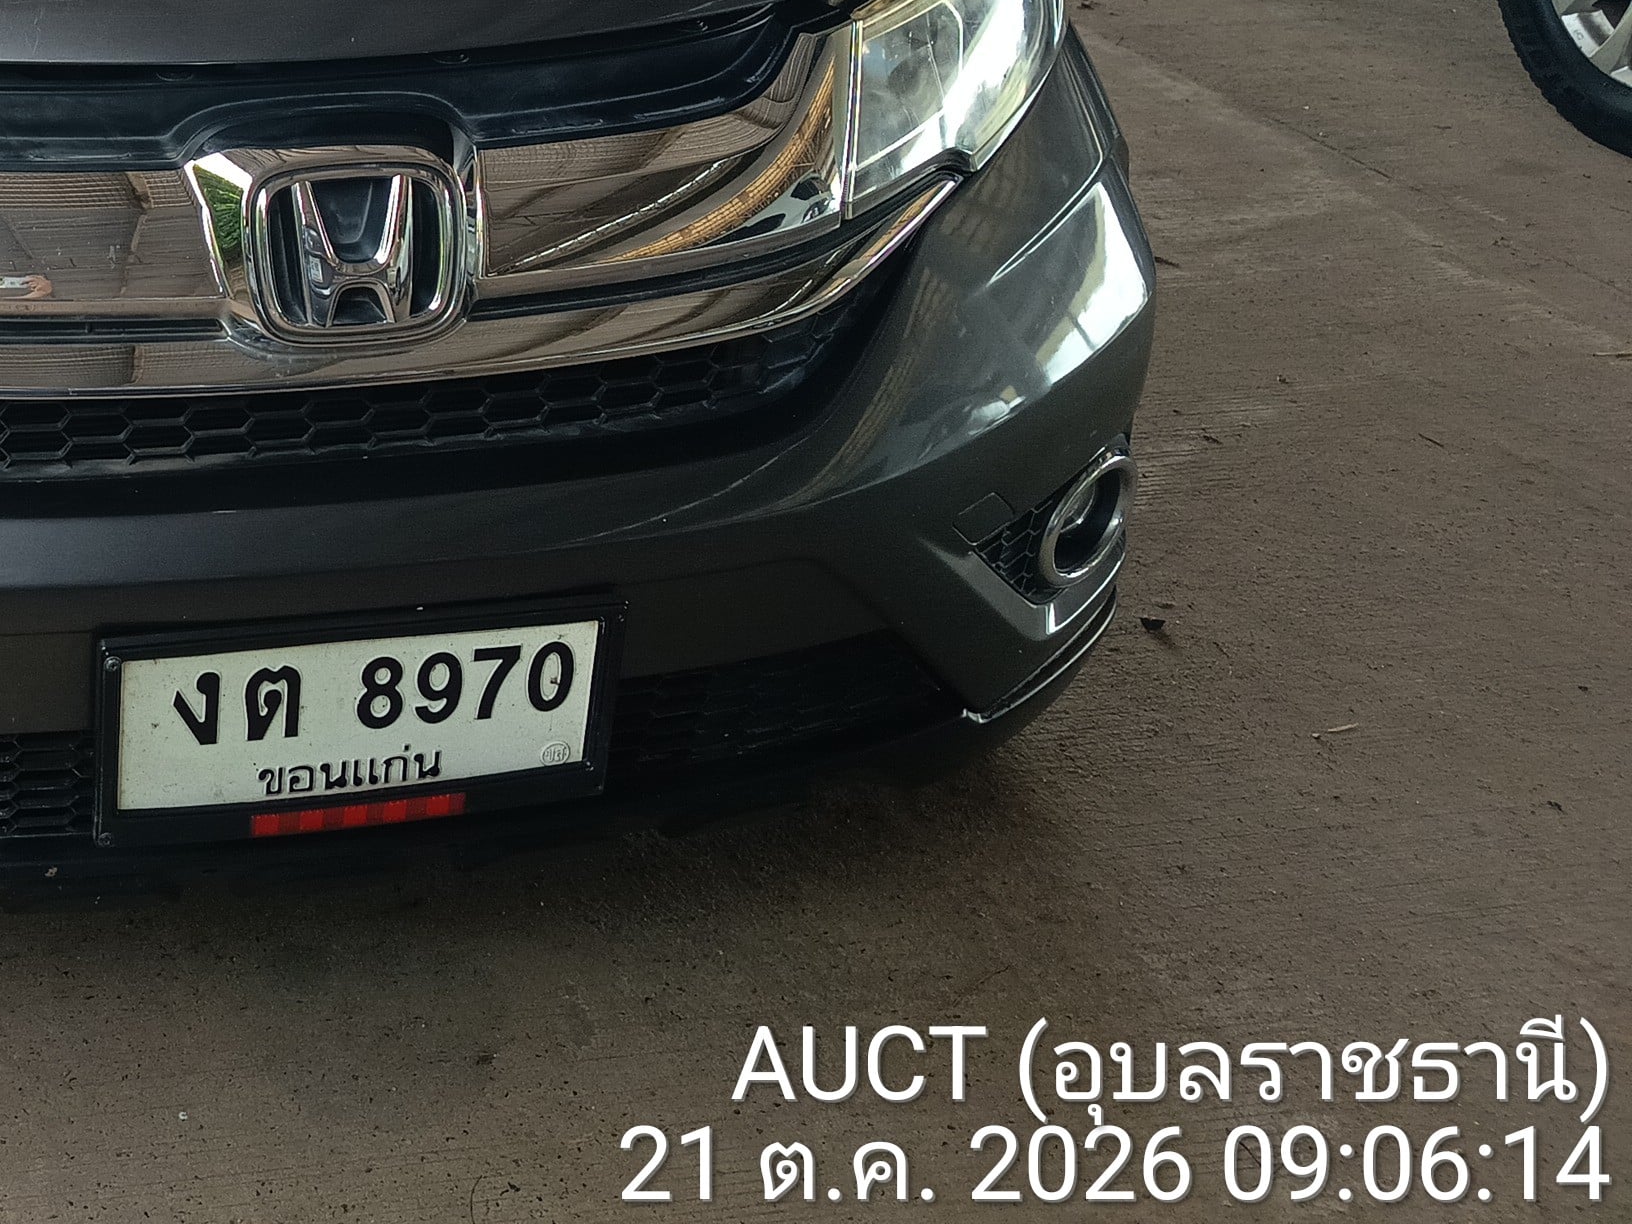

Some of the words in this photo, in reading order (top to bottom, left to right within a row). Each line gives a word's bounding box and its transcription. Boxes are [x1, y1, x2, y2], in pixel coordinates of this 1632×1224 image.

[172, 665, 302, 746] งต
[356, 641, 575, 730] 8970
[257, 744, 443, 797] ขอนแก่น
